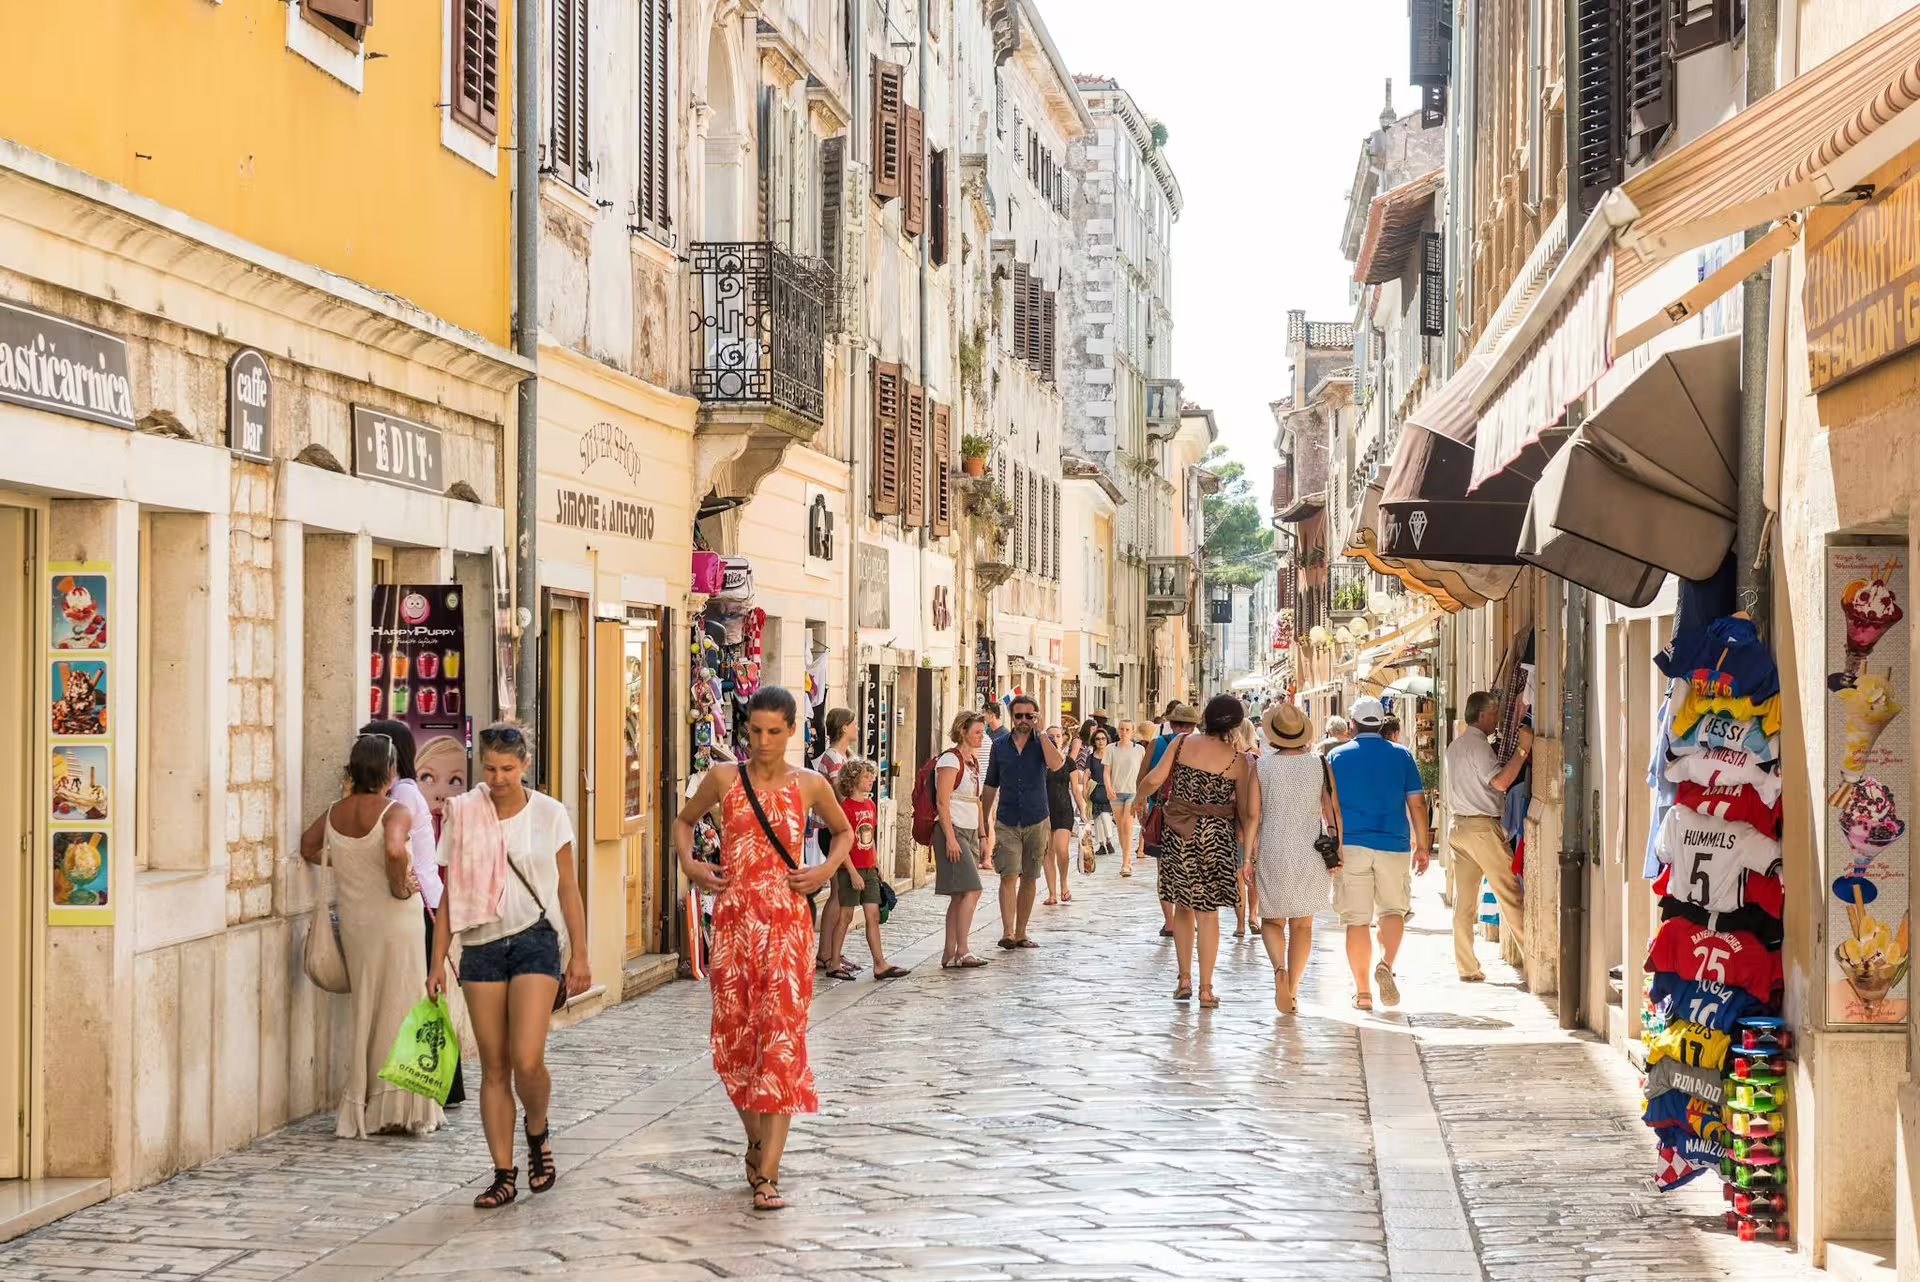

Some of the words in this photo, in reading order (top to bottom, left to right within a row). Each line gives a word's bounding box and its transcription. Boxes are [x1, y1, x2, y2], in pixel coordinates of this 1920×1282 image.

[0, 333, 133, 419] astičarnica
[236, 366, 267, 408] caffe
[242, 409, 264, 453] bar
[580, 422, 612, 474] SILVER
[614, 426, 641, 487] SHOP
[602, 504, 608, 531] &
[1684, 829, 1736, 850] HUMMELS
[1687, 852, 1713, 907] 5
[1693, 946, 1730, 986] 25
[1687, 1022, 1714, 1041] EUS
[399, 1063, 443, 1089] ornament
[1672, 1072, 1722, 1103] RONALDO
